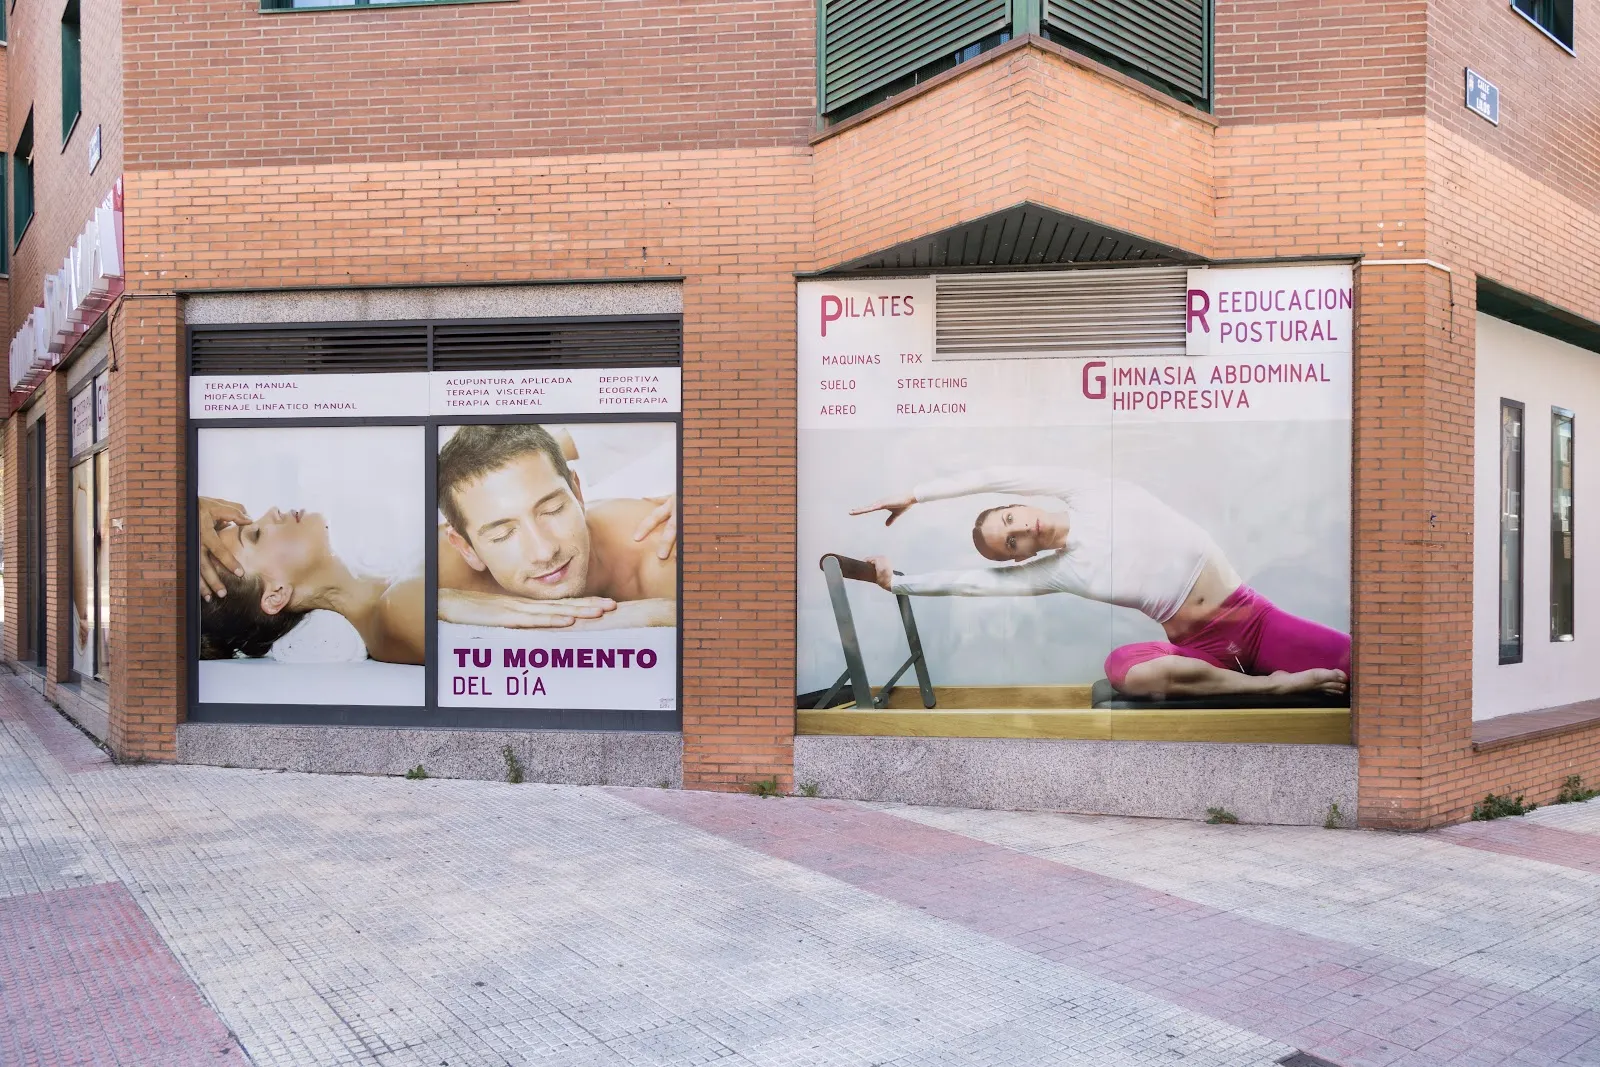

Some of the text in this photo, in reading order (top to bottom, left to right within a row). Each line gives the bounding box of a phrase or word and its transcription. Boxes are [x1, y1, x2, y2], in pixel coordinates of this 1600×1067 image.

[821, 295, 914, 337] PILATES
[1221, 320, 1337, 343] POSTURAL
[822, 355, 881, 366] MAQUINAS
[899, 354, 923, 364] TRX
[599, 375, 659, 383] DEPORTIVA
[1210, 364, 1330, 384] ABDOMINAL
[204, 382, 250, 390] TERAPIA
[445, 377, 573, 386] ACUPUNTURA APLICADA
[820, 380, 856, 391] SUELO
[897, 378, 968, 389] STRETCHING
[496, 388, 546, 396] VISCERAL
[599, 386, 658, 394] ECOGRAFIA
[204, 393, 265, 401] MIOFASCIAL
[599, 397, 668, 405] FITOTERAPIA
[1114, 390, 1249, 410] HIPOPRESIVA
[255, 403, 309, 411] LINFATICO
[314, 402, 359, 410] MANUAL
[445, 398, 543, 407] TERAPIA CRANEAL
[820, 405, 857, 415] AEREO
[896, 404, 966, 414] RELAJACION
[454, 649, 657, 668] TU MOMENTO
[454, 670, 546, 695] DEL DÍA
